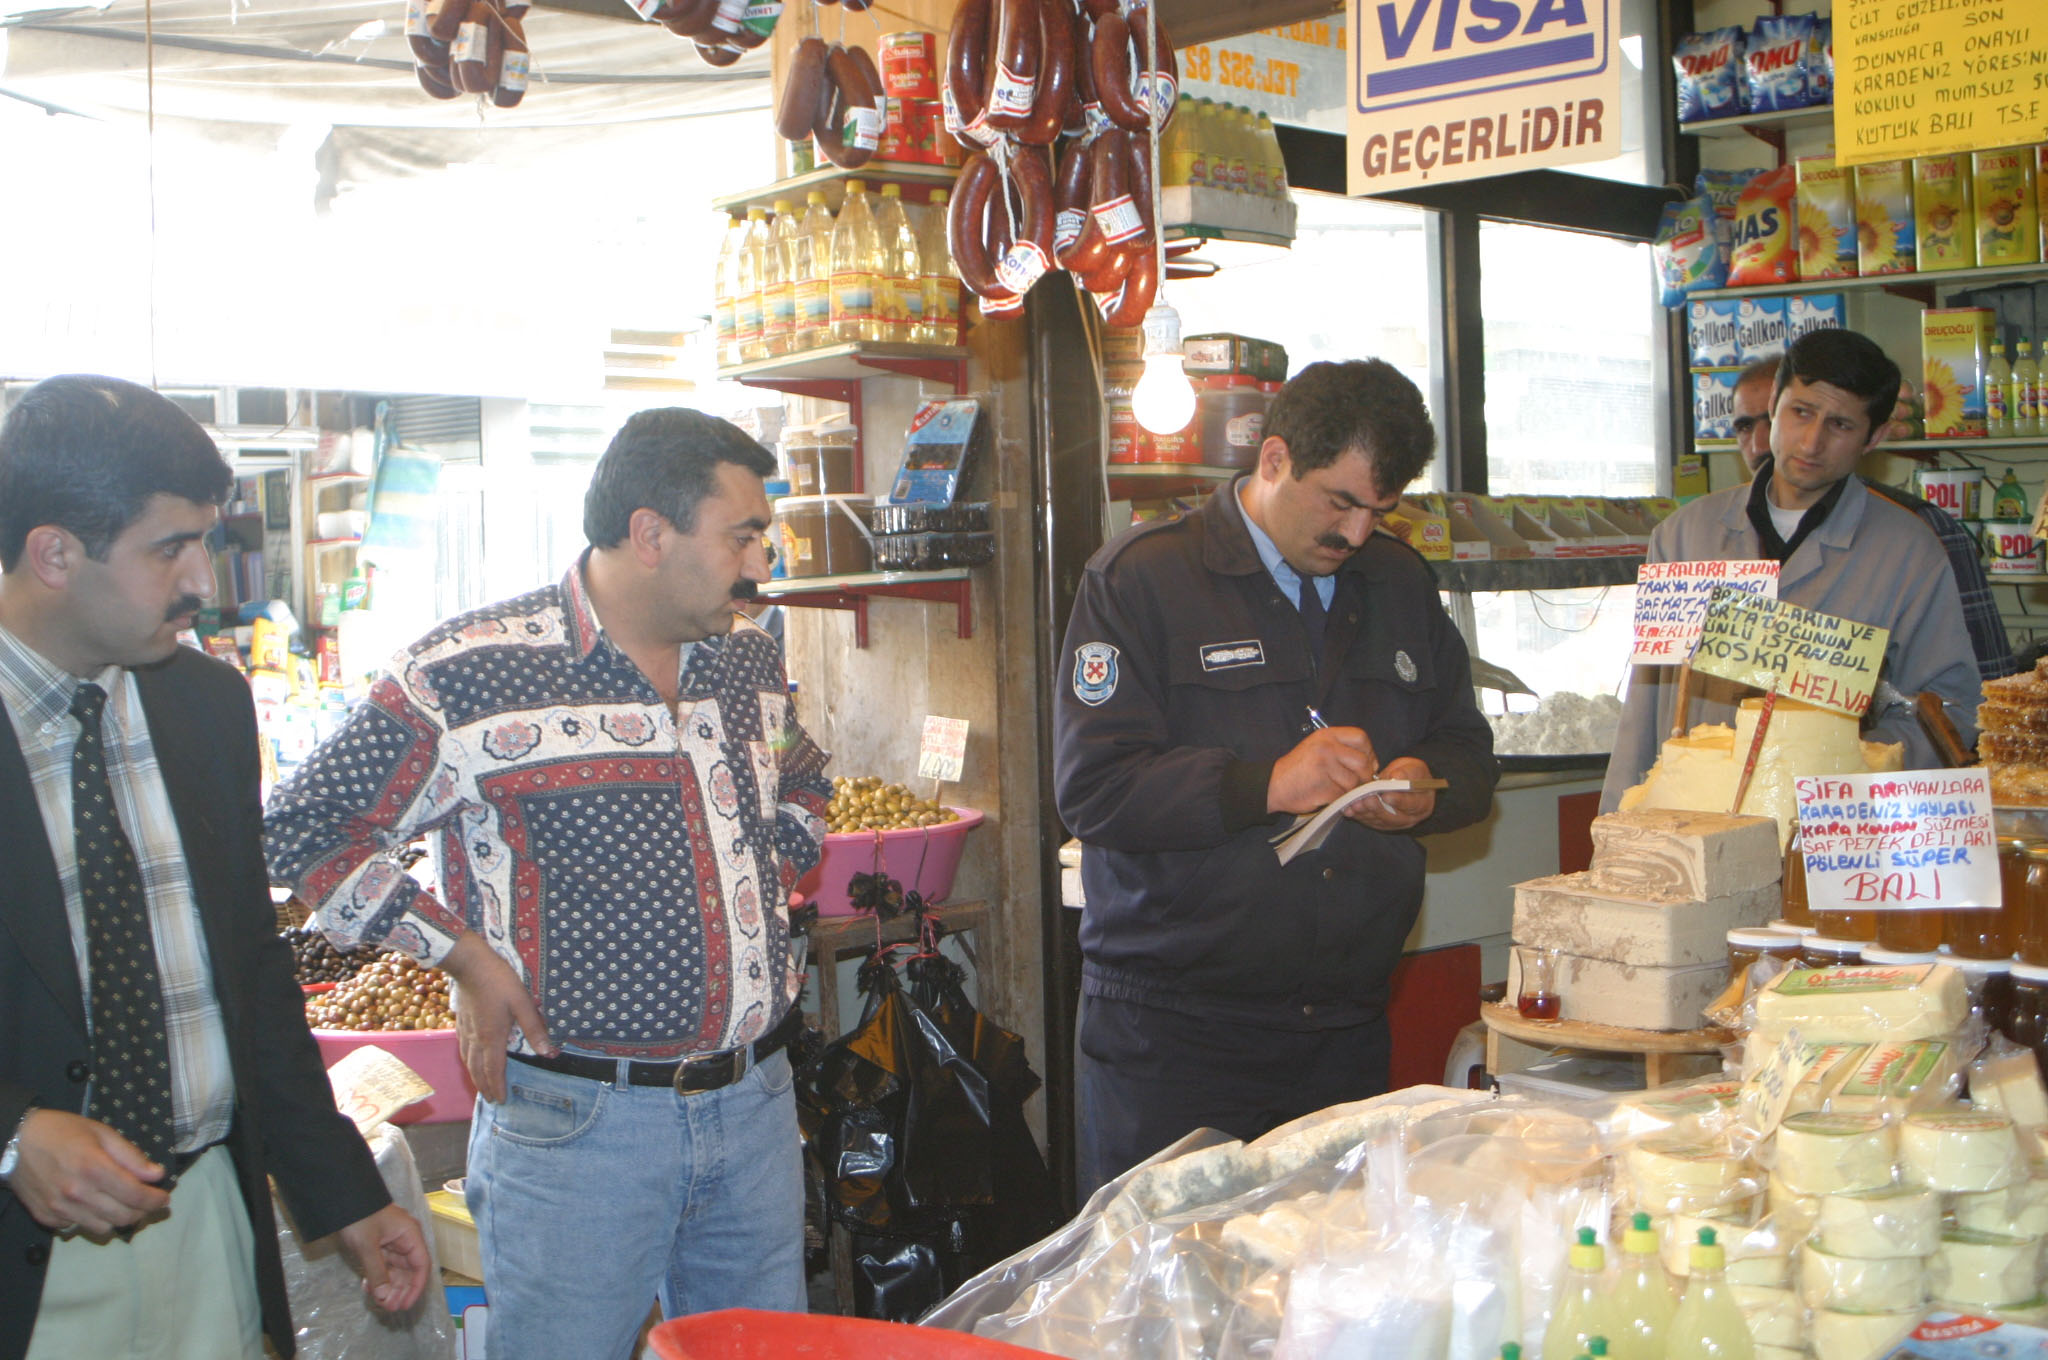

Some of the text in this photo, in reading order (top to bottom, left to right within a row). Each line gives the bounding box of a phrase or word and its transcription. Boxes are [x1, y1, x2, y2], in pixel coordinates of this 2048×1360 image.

[1963, 8, 2004, 27] SON
[1377, 0, 1588, 61] VISA
[1964, 27, 2030, 52] ONAYLI
[1855, 94, 1916, 116] KOKULU
[1363, 98, 1604, 179] GEÇERLİDİR
[1856, 118, 1920, 145] KÜTÜK
[1928, 111, 1974, 135] BALI
[1925, 483, 1960, 509] POL
[2000, 533, 2037, 558] POL
[1639, 561, 1727, 580] SOFRALARA
[1636, 580, 1689, 595] TRAKYA
[1703, 619, 1754, 641] ÜNLÜ
[1851, 624, 1876, 641] VE
[1697, 635, 1788, 674] KOSKA
[1789, 671, 1872, 714] HELVA
[1796, 777, 1985, 805] ŞİFA ARAYANLARA
[1801, 821, 1852, 838] KARA
[1923, 813, 1990, 832] SÜZMESİ
[1802, 839, 1836, 854] SAF
[1839, 834, 1905, 852] PETEK
[1963, 831, 1993, 846] ARI
[1891, 847, 1972, 868] SÜPER
[1843, 869, 1942, 902] BALI
